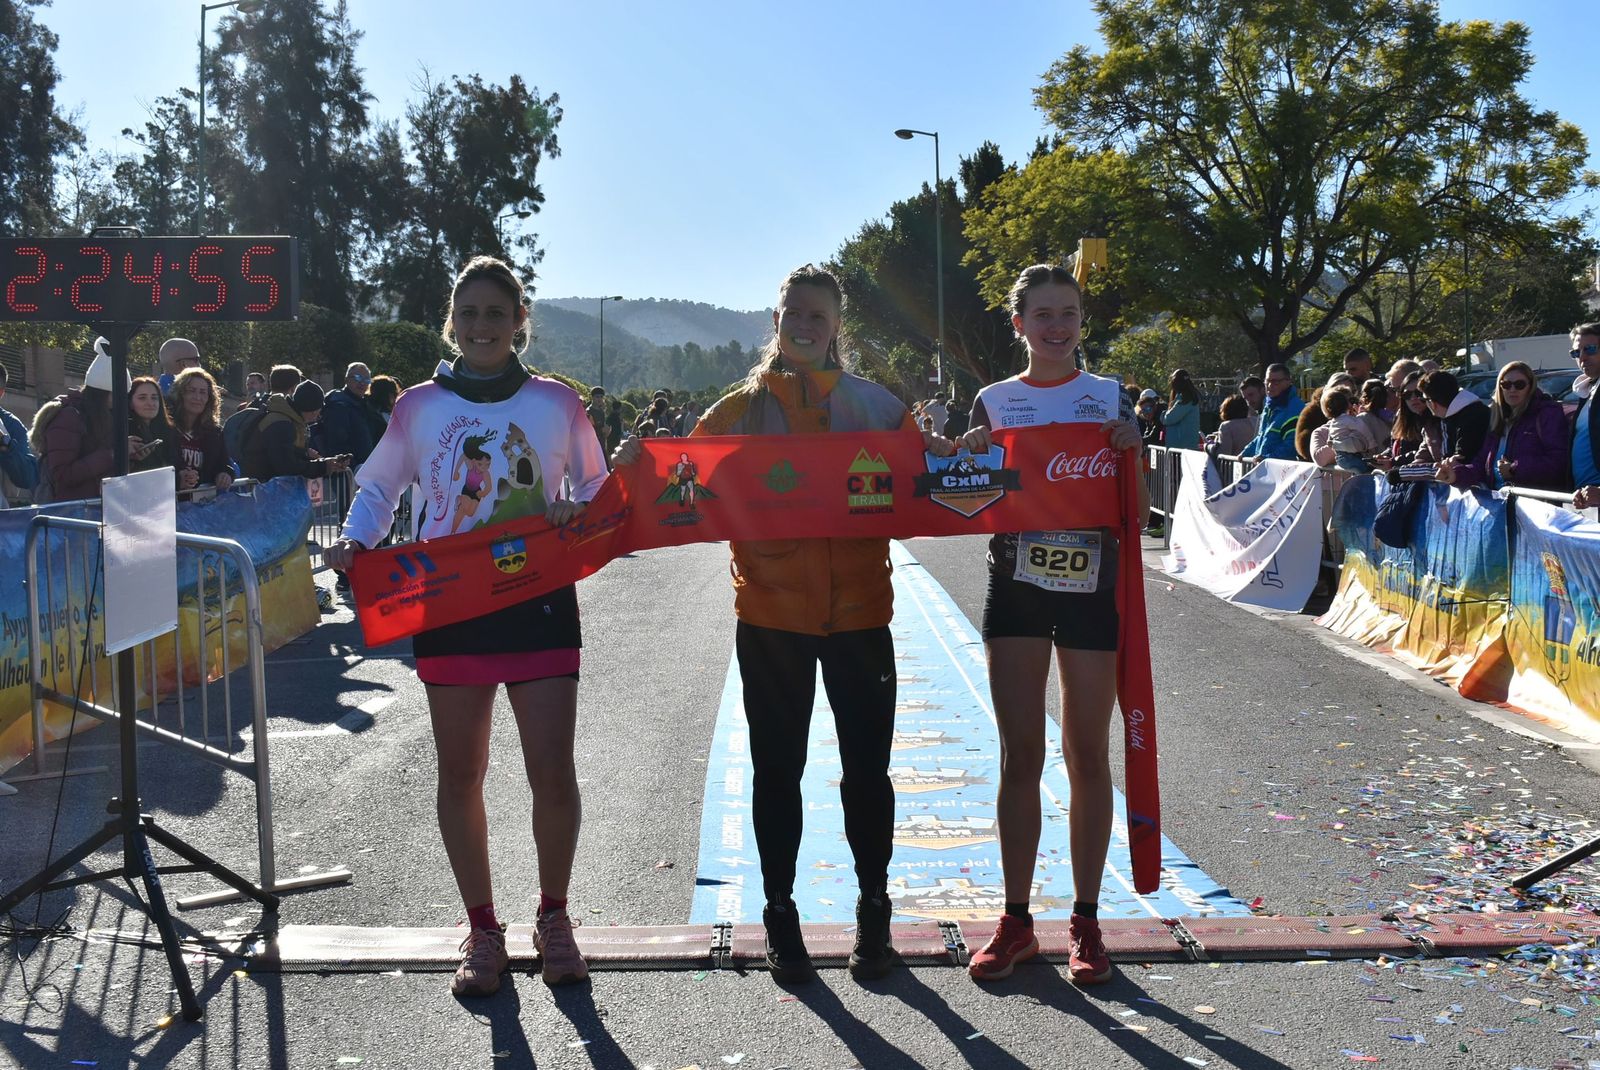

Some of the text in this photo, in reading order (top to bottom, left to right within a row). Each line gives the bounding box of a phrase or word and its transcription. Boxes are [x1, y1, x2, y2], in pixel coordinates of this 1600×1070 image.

[6, 245, 280, 313] 2:24:55
[1046, 447, 1118, 482] Coca-Co
[850, 495, 891, 505] TRAIL
[1058, 534, 1080, 543] CXM
[1029, 546, 1089, 572] 820
[375, 582, 420, 600] Diputación
[1, 602, 80, 649] Ayuamieo
[0, 656, 48, 689] lhaun
[889, 859, 958, 870] quista
[963, 857, 991, 868] del
